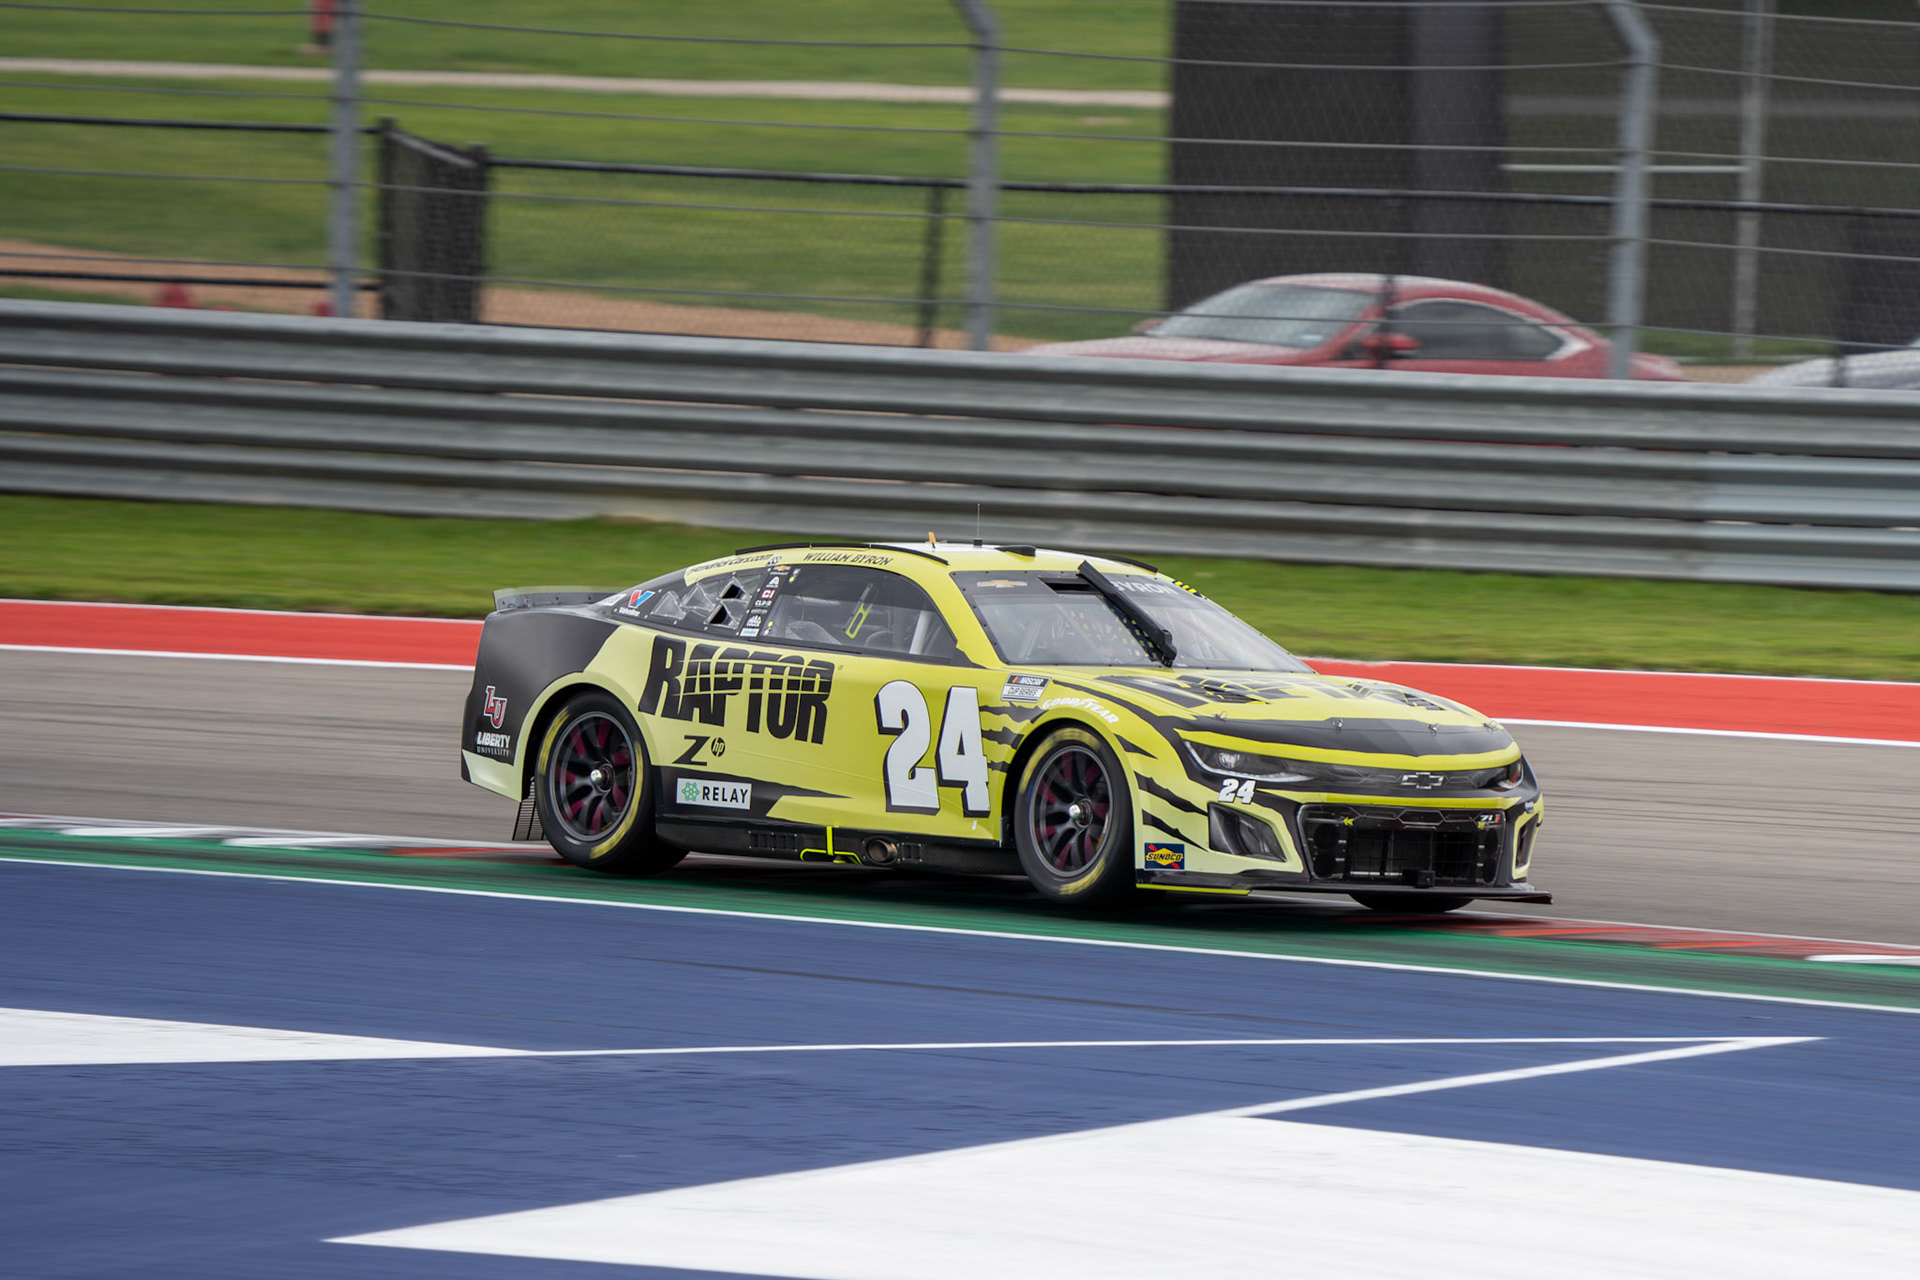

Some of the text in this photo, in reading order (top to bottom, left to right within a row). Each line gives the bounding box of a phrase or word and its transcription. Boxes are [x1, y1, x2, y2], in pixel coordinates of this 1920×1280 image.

[803, 552, 893, 566] WILLIAM BYRON
[638, 635, 835, 745] RAPTOR
[483, 685, 508, 729] LU
[1041, 697, 1119, 724] GOODYEAR
[476, 731, 511, 749] LIBERTY
[476, 745, 510, 757] UNIVERSITY
[672, 735, 726, 766] Z hp
[873, 679, 991, 819] 24
[702, 786, 749, 803] RELAY
[1218, 778, 1256, 805] 24
[1147, 853, 1182, 861] SUNOCO
